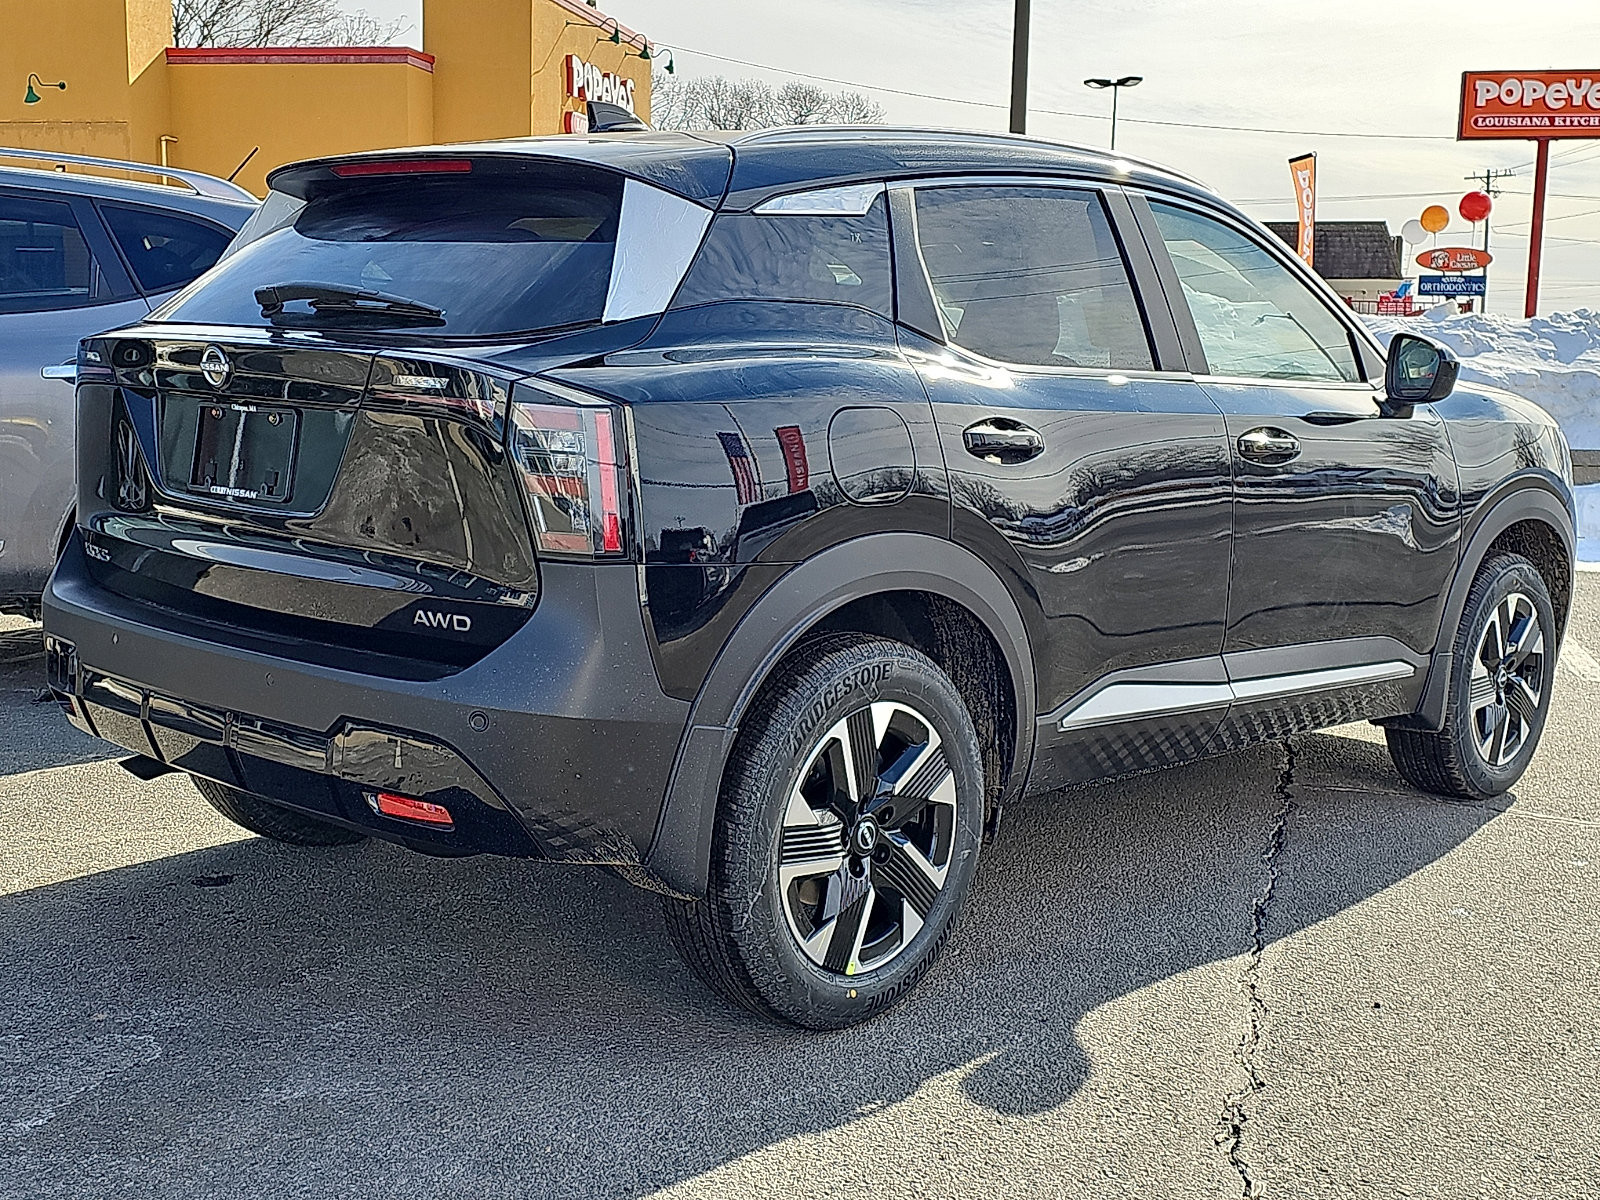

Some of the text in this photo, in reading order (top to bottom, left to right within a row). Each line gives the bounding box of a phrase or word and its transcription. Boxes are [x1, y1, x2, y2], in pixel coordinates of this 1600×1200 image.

[1477, 116, 1600, 127] LOUISIANA KITCH
[1456, 251, 1476, 262] Little
[1420, 281, 1485, 292] ORTHODONTICS
[225, 487, 259, 499] NISSAN
[413, 609, 472, 632] AWD
